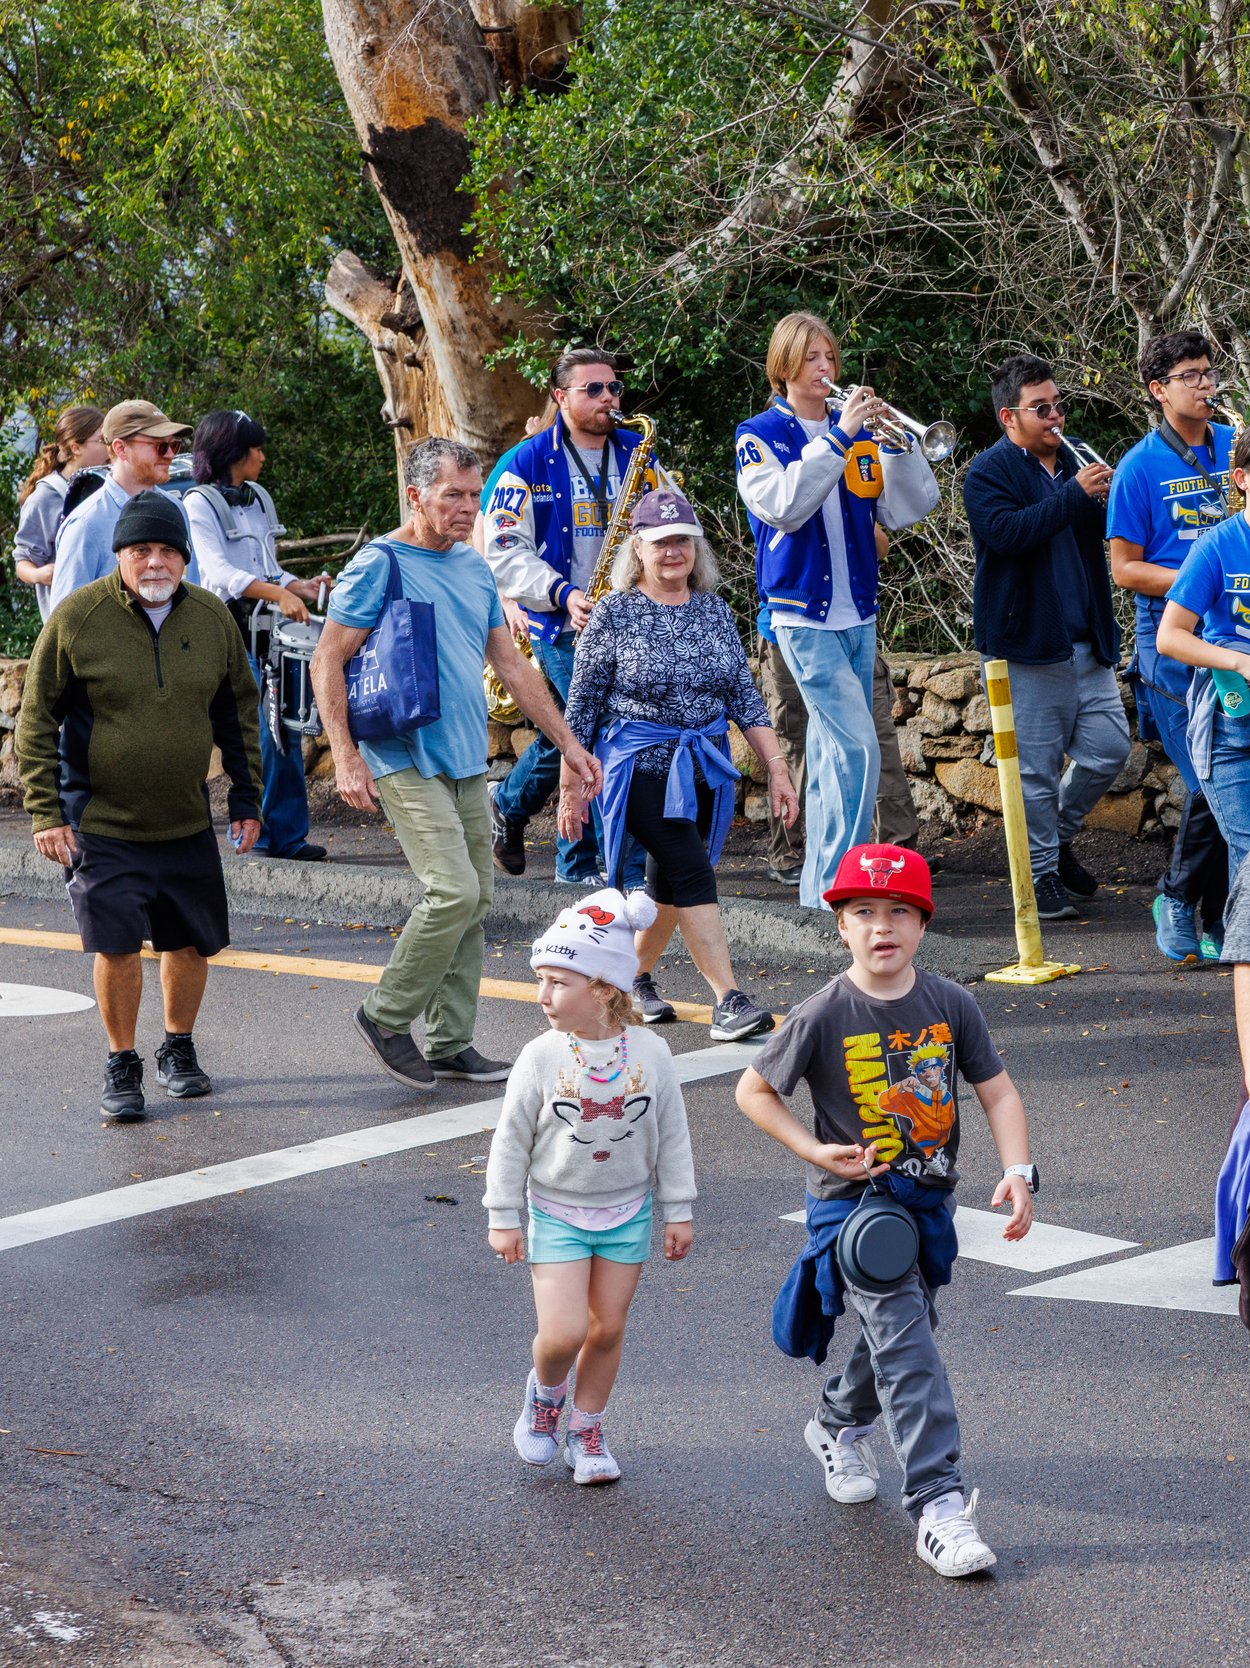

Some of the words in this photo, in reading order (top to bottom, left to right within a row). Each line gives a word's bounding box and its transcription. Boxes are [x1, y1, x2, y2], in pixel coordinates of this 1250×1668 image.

[489, 486, 527, 518] 2027
[545, 944, 578, 960] Kitty
[842, 1032, 904, 1163] NARUTO
